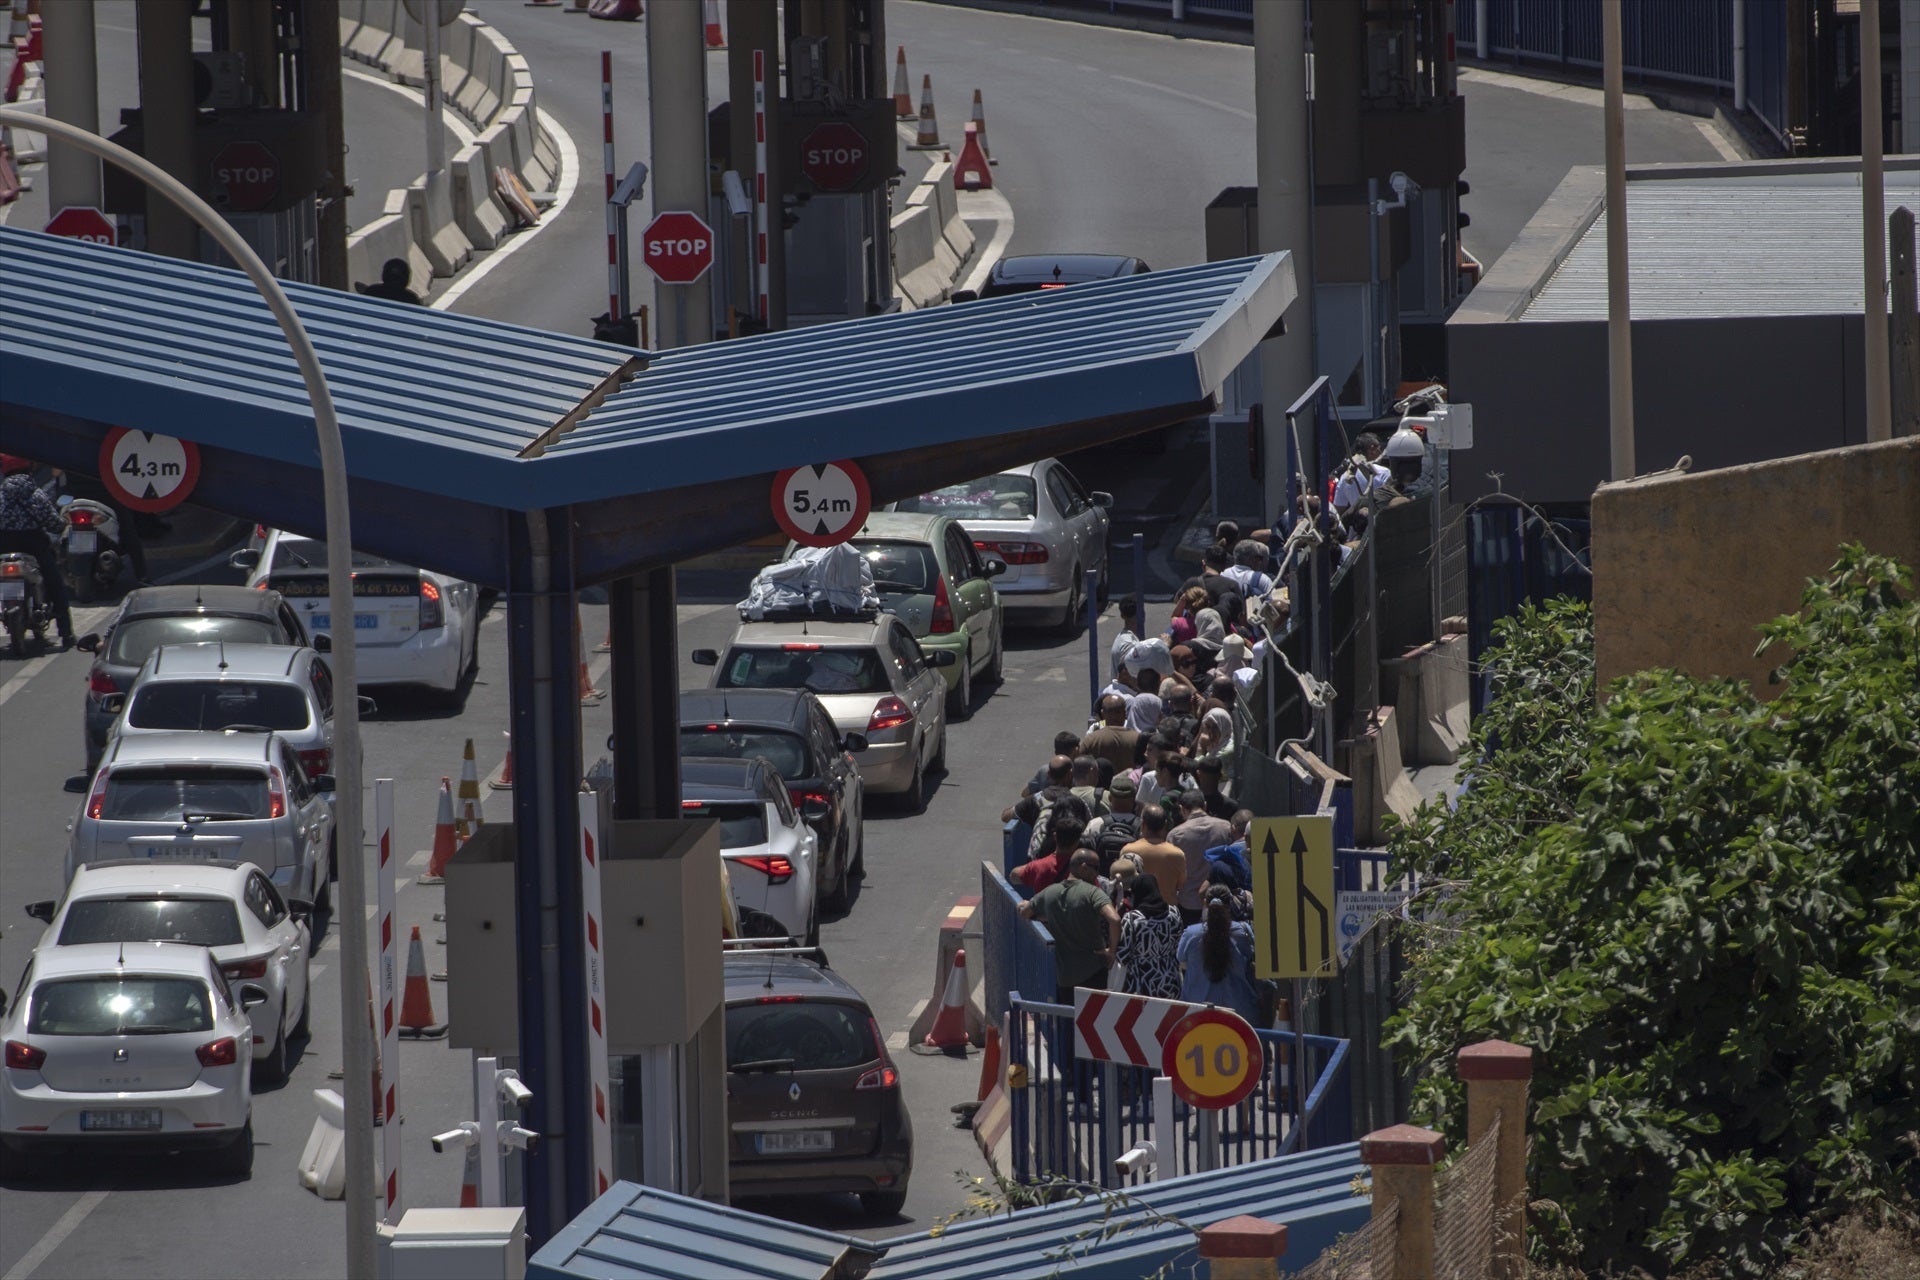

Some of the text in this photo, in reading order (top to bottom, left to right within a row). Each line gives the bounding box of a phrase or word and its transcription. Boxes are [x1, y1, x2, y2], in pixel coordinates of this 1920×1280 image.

[808, 148, 862, 165] STOP
[218, 167, 274, 184] STOP
[649, 239, 707, 256] STOP
[385, 584, 409, 593] TAXI
[1350, 895, 1381, 903] OBLIGATORIO
[1185, 1043, 1240, 1077] 10
[770, 1109, 819, 1118] SCENIC
